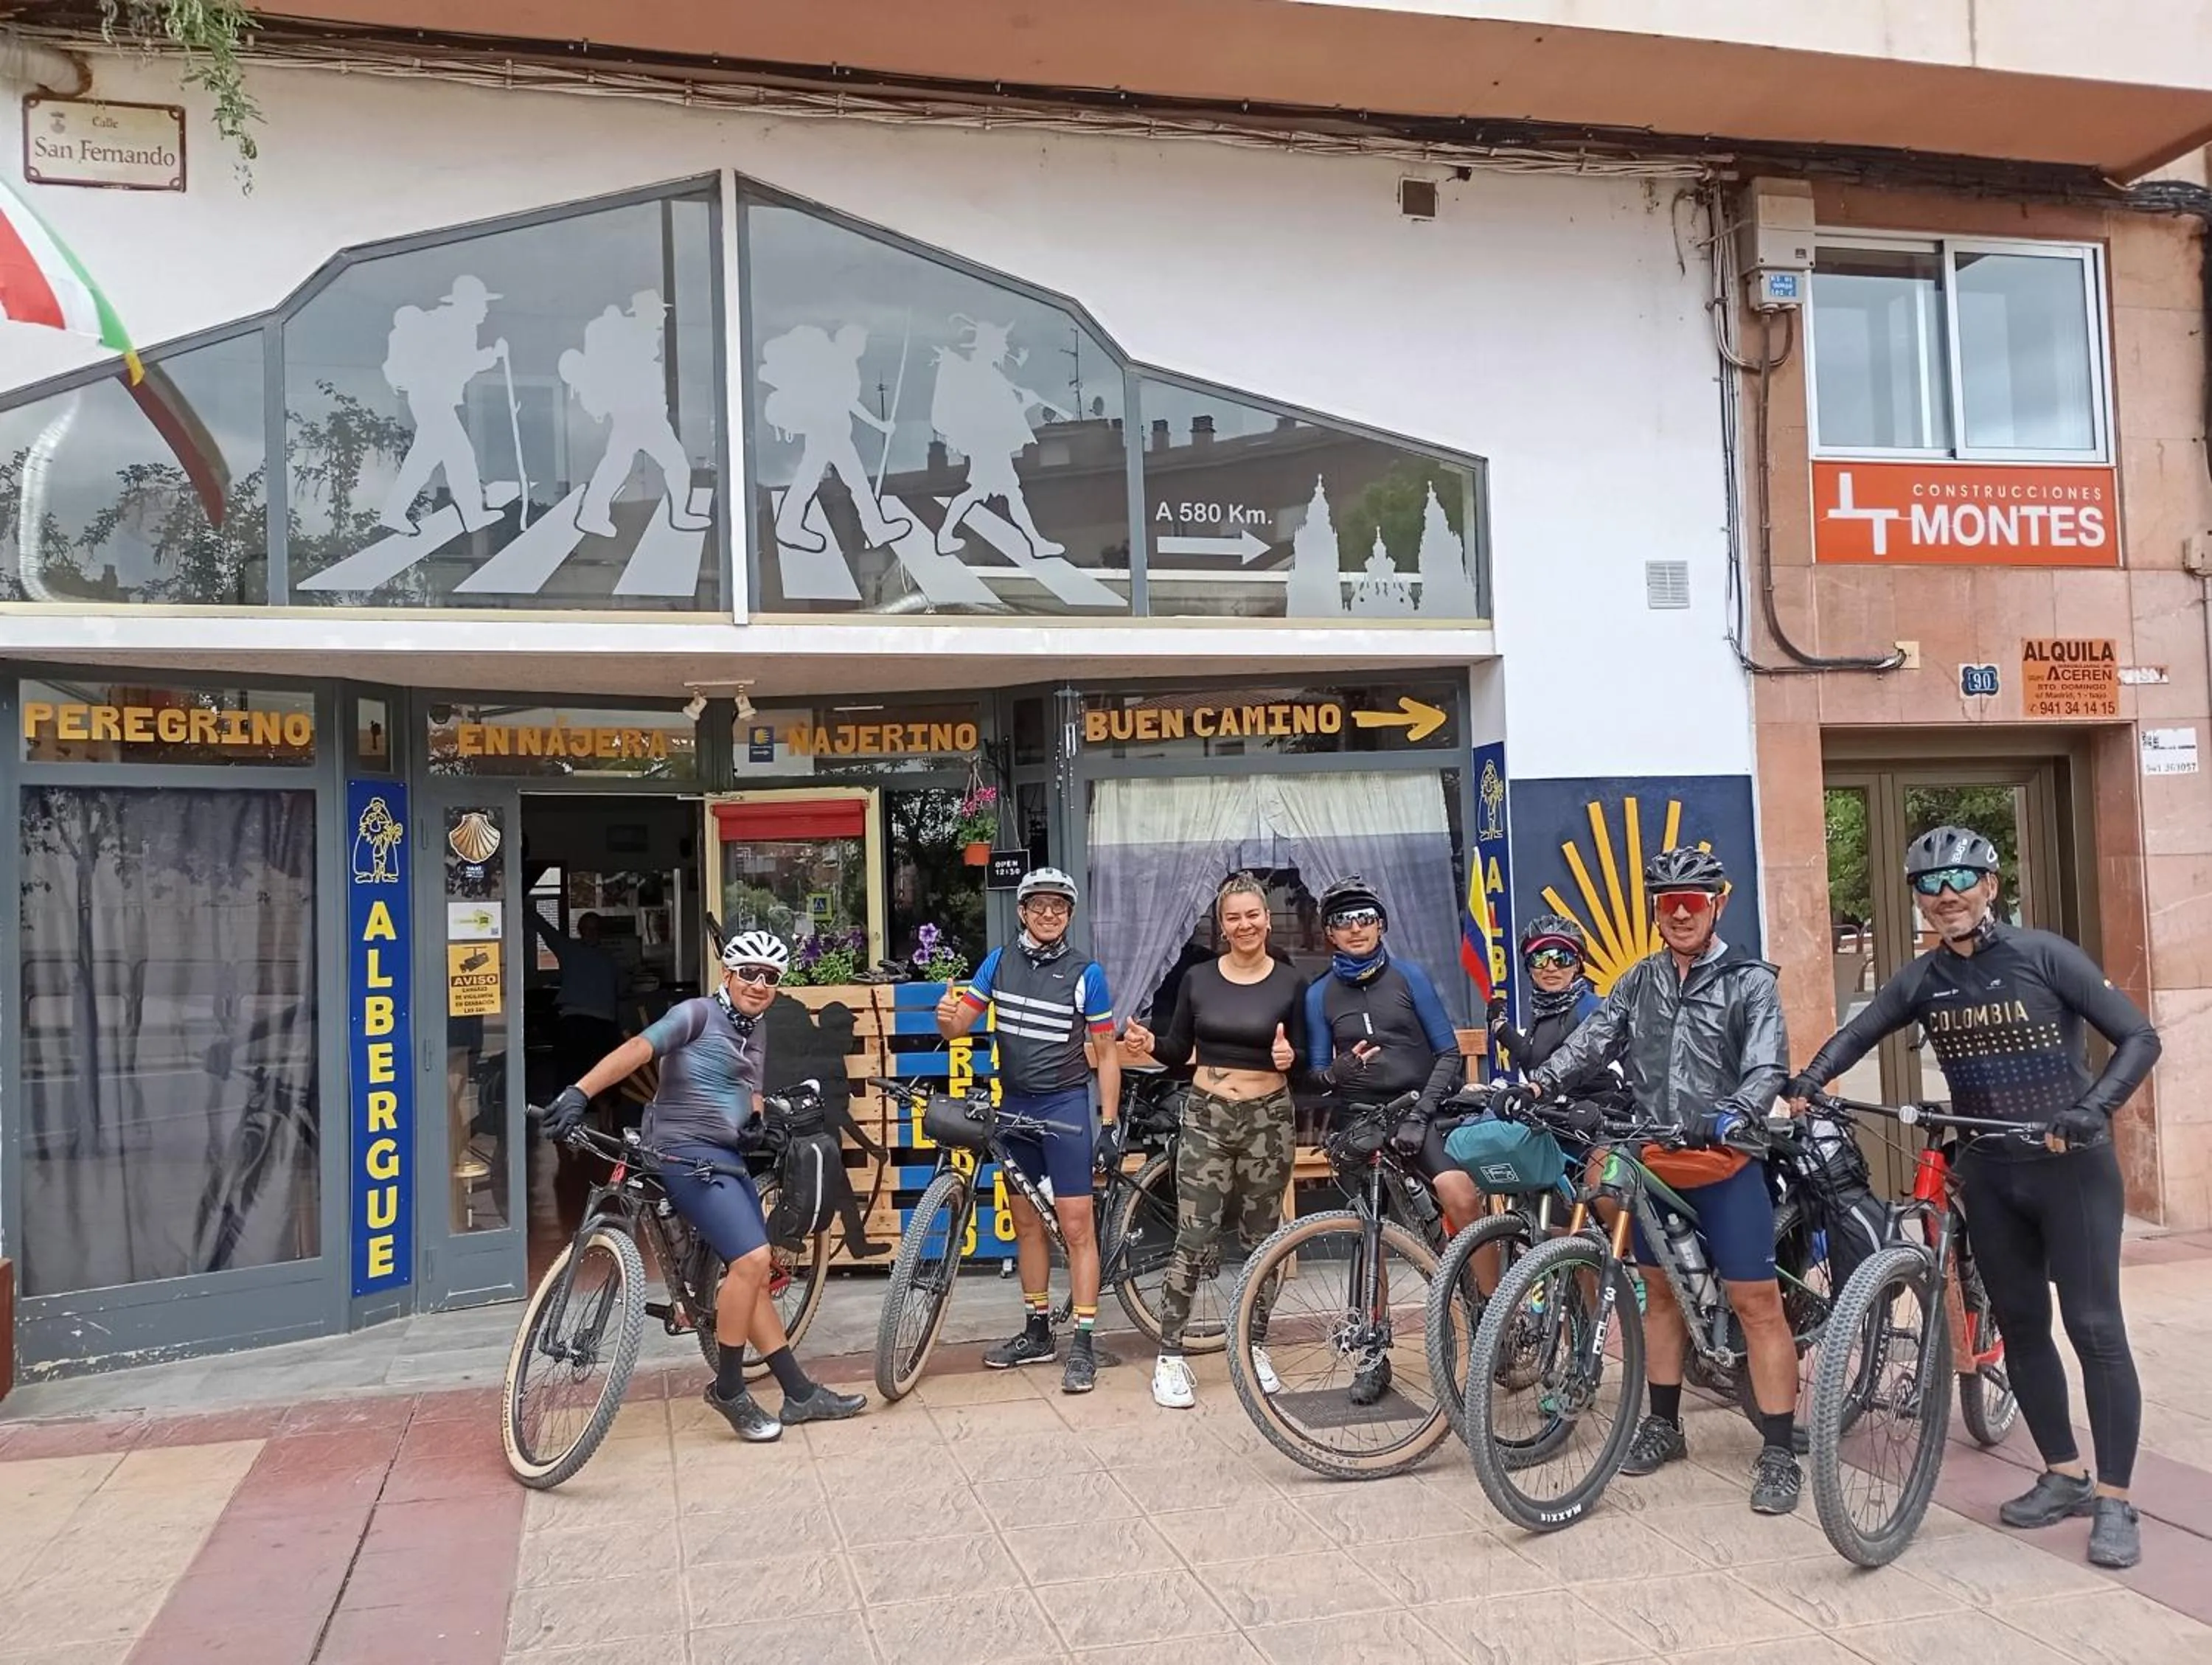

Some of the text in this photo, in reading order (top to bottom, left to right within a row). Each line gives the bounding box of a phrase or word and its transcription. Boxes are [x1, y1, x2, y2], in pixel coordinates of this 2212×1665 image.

[92, 116, 119, 129] Calle
[35, 136, 175, 167] San Fernando
[1912, 483, 2102, 501] CONSTRUCCIONES
[1155, 501, 1273, 525] A 580 Km.
[1910, 504, 2106, 546] MONTES
[2023, 641, 2115, 662] ALQUILA
[1972, 673, 1991, 689] 90
[2039, 701, 2116, 715] 941 34 14 15
[24, 702, 312, 746] PEREGRINO
[1084, 703, 1343, 743] BUEN CAMINO
[457, 715, 667, 759] EN NÁJERA
[995, 860, 1018, 868] OPEN
[453, 975, 496, 986] AVISO
[1930, 999, 2030, 1032] COLOMBIA
[363, 900, 400, 1279] ALBERGUE
